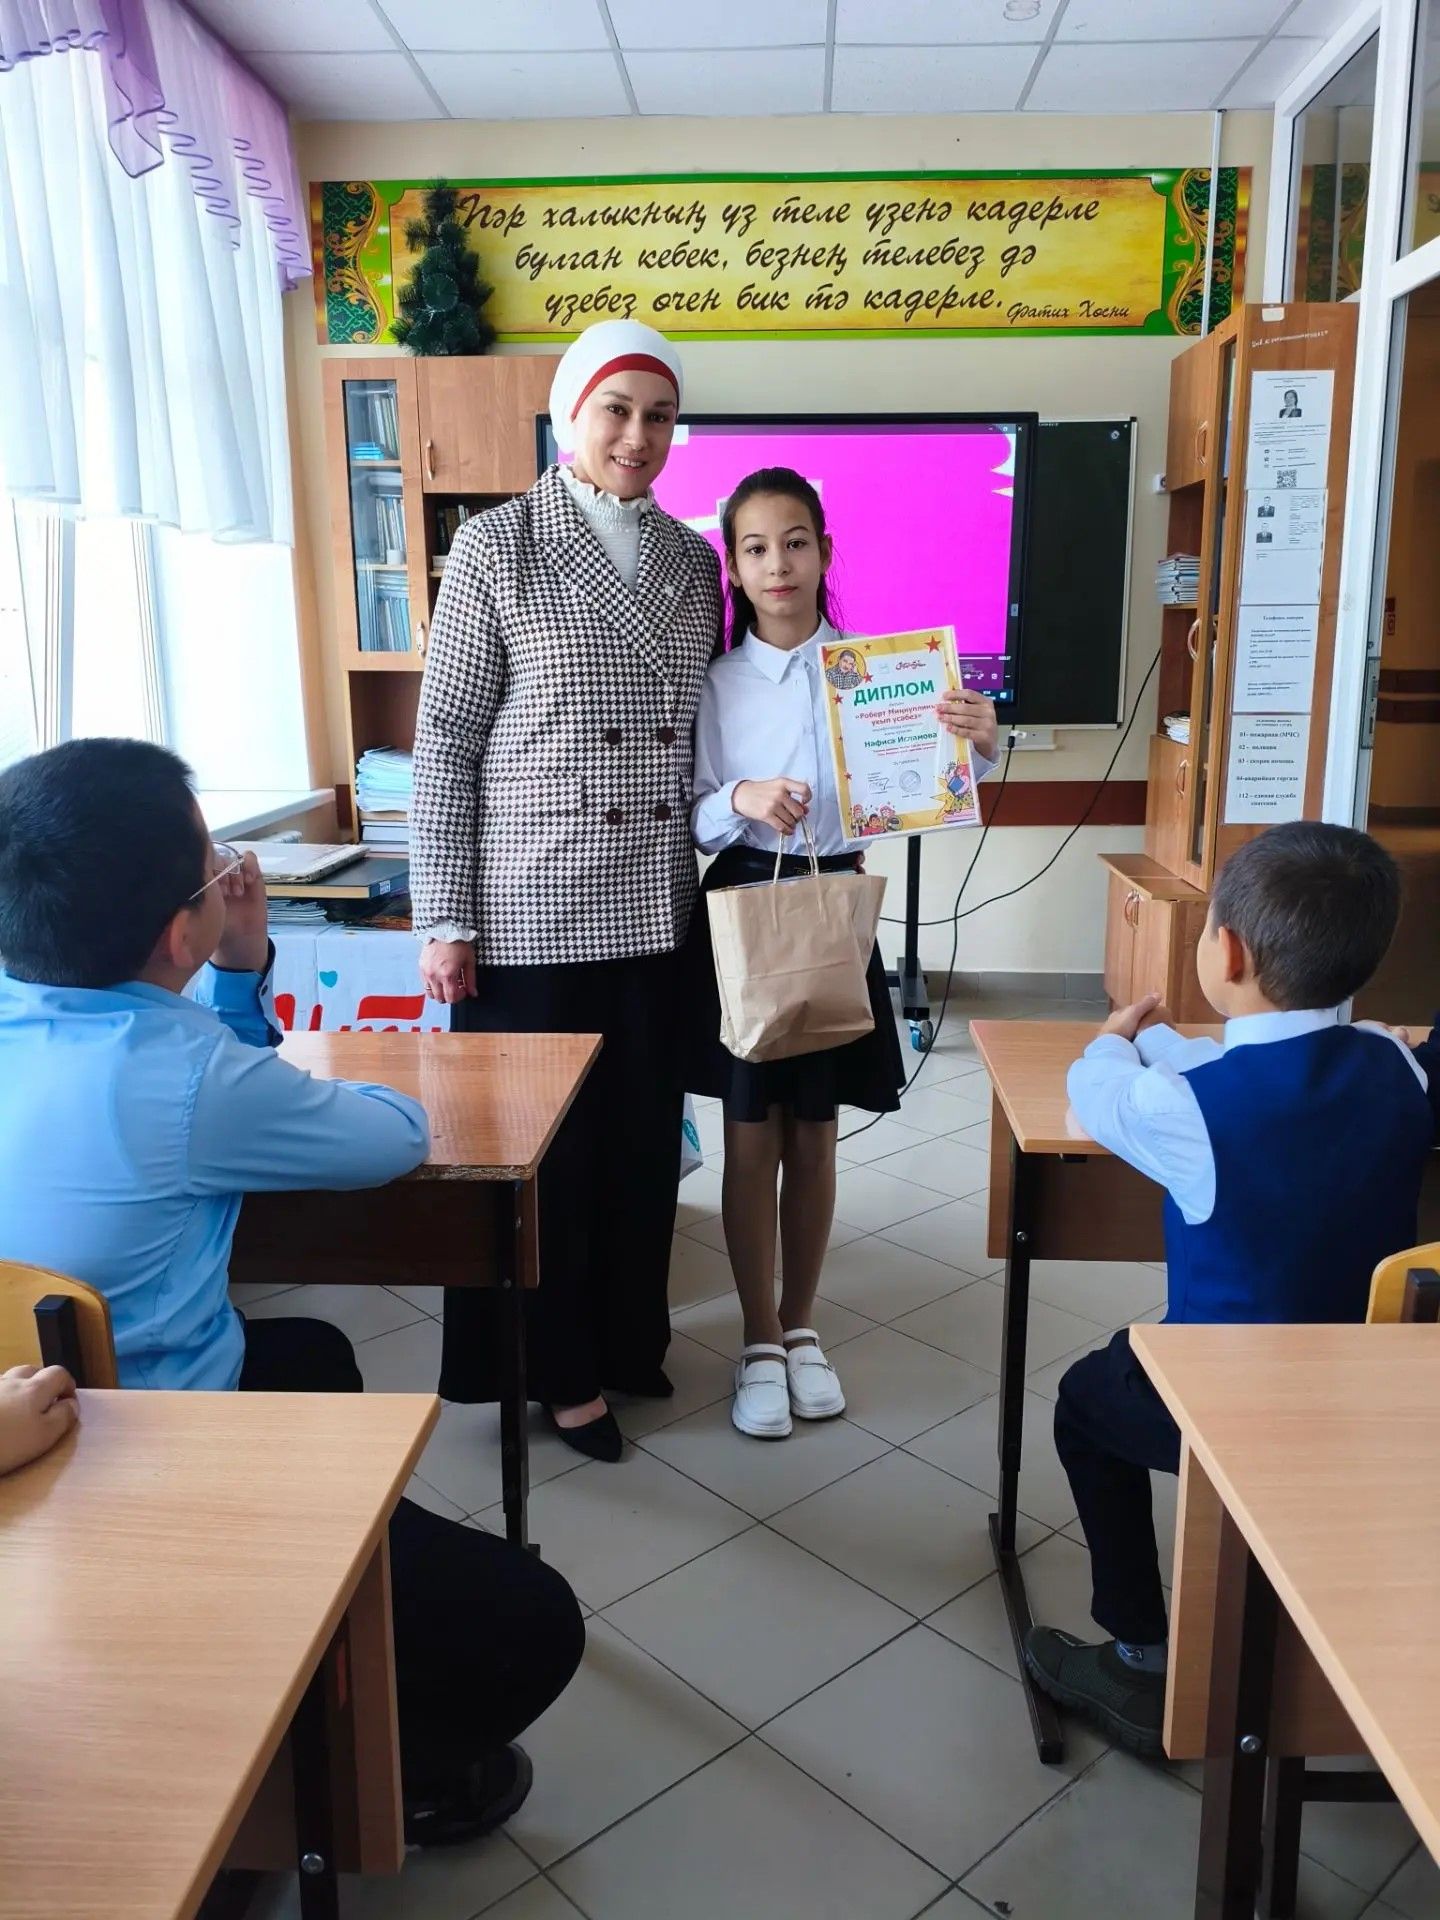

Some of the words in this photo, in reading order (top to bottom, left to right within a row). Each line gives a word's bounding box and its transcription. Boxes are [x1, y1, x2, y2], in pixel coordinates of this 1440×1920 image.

[542, 199, 707, 235] халыкның
[772, 195, 851, 224] теле
[967, 195, 1100, 235] кадерле
[515, 242, 624, 282] булган
[637, 239, 728, 271] кебек,
[745, 238, 848, 282] безнең
[862, 236, 985, 280] телебез
[1000, 244, 1037, 279] дә
[736, 282, 791, 312] бик
[804, 282, 850, 311] тә
[863, 284, 1003, 323] кадерле.
[1006, 302, 1070, 325] Фатих
[853, 679, 935, 706] ДИПЛОМ
[897, 732, 938, 744] Исламова
